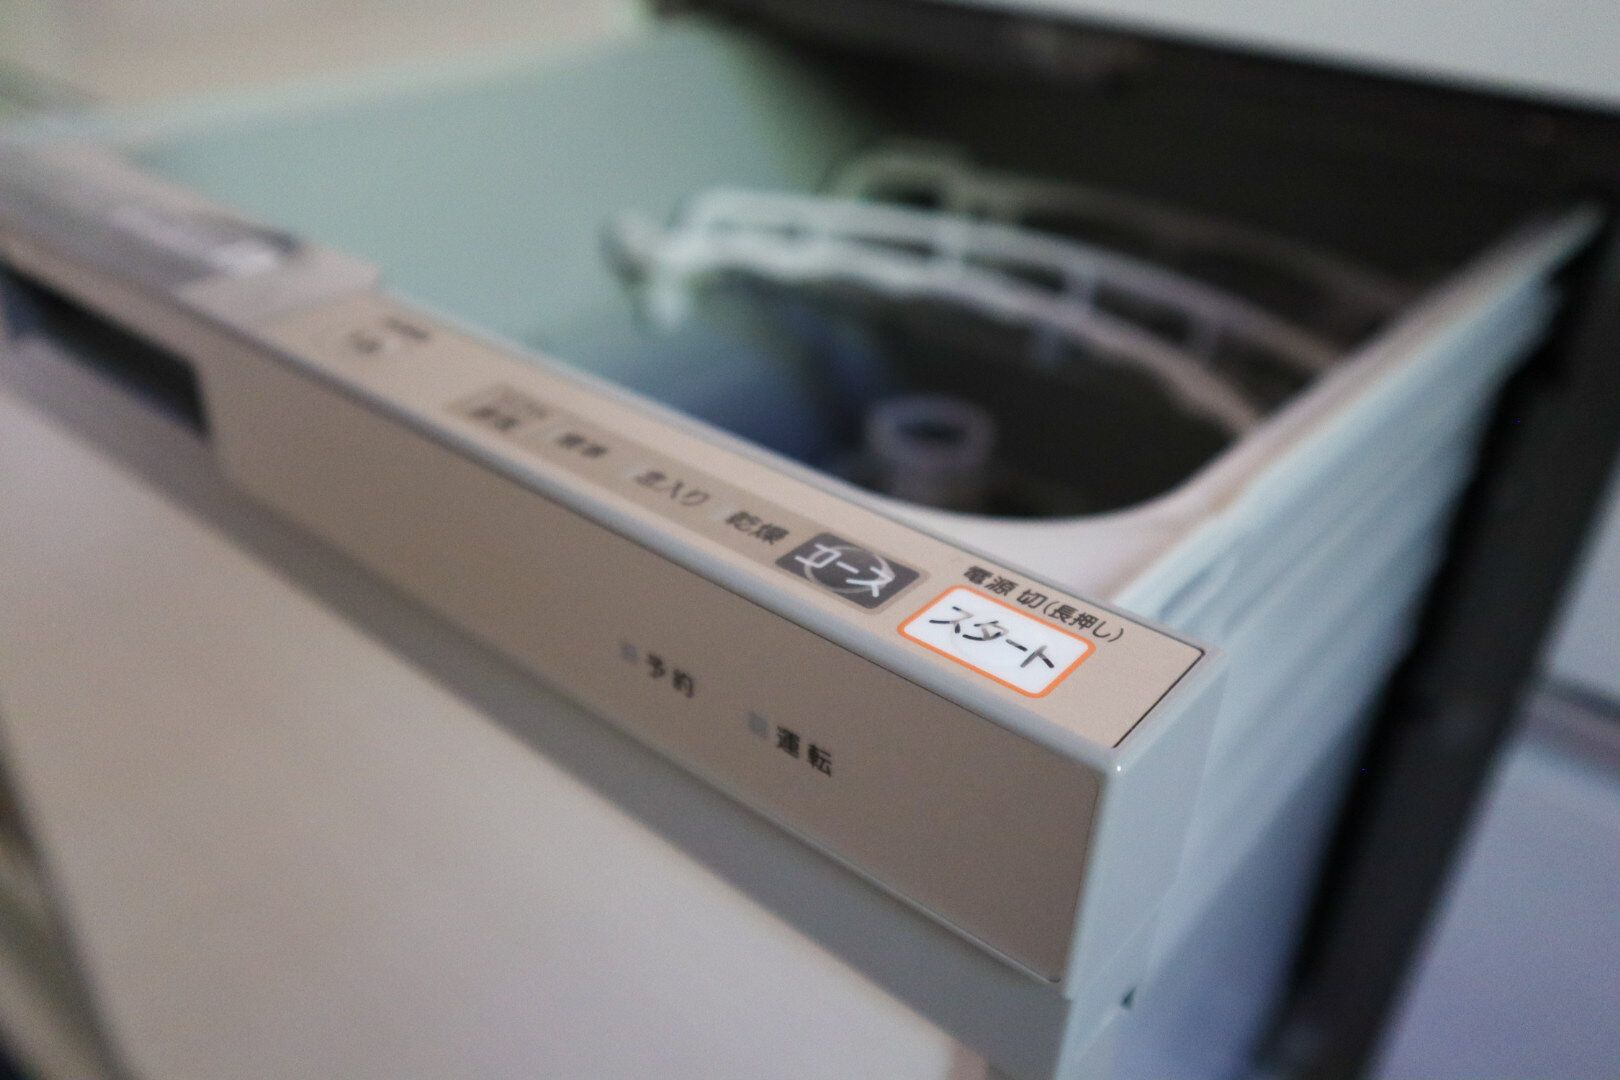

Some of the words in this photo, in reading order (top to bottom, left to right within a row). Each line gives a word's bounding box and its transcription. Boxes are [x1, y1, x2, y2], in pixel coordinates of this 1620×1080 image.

[794, 542, 896, 598] コース
[963, 565, 1019, 597] 電源
[929, 606, 1055, 669] スタート
[776, 725, 833, 778] 運転
